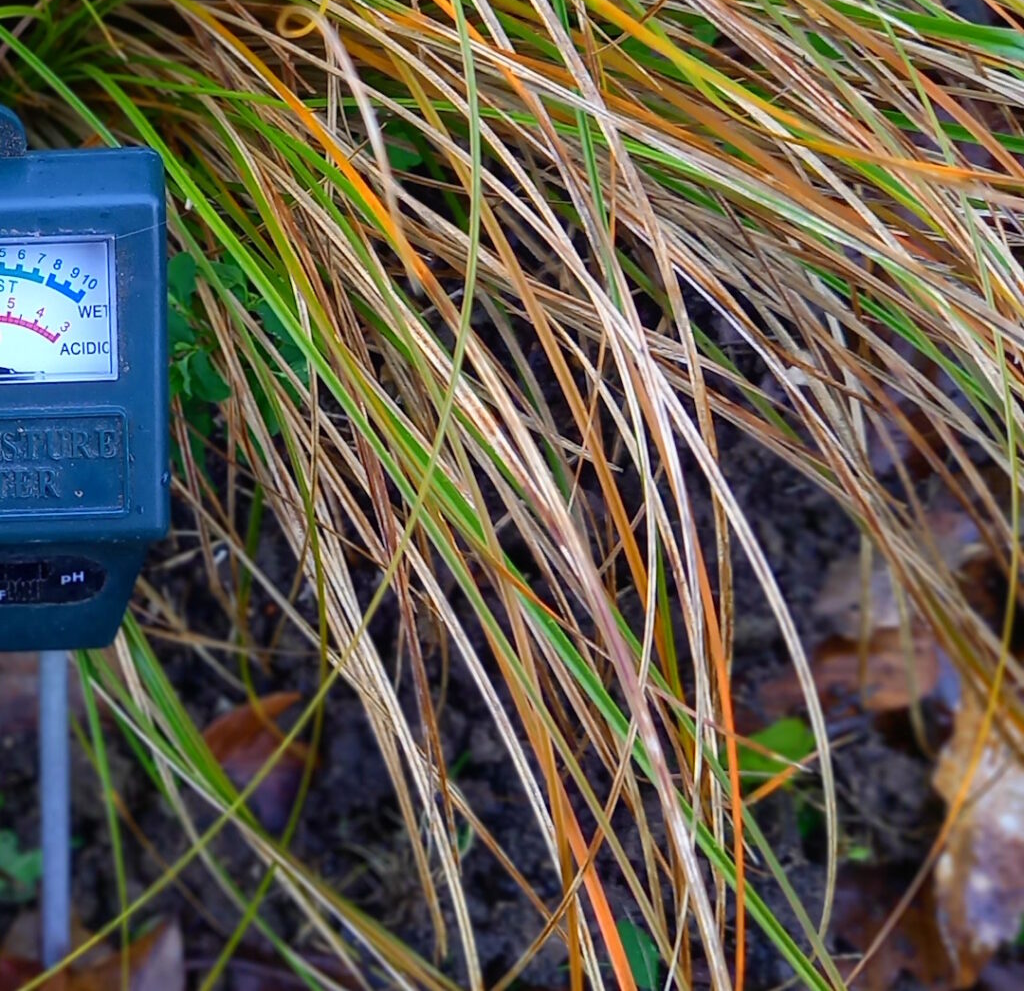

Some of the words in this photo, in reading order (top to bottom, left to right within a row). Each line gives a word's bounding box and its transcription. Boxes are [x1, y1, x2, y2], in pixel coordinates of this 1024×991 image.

[18, 249, 26, 260] 6
[37, 253, 47, 264] 7
[53, 258, 63, 271] 8
[70, 267, 80, 279] 9
[82, 274, 98, 290] 10
[7, 297, 16, 309] 5
[36, 307, 45, 319] 4
[60, 321, 70, 333] 3
[60, 341, 109, 356] ACIDIC
[61, 570, 85, 586] pH
